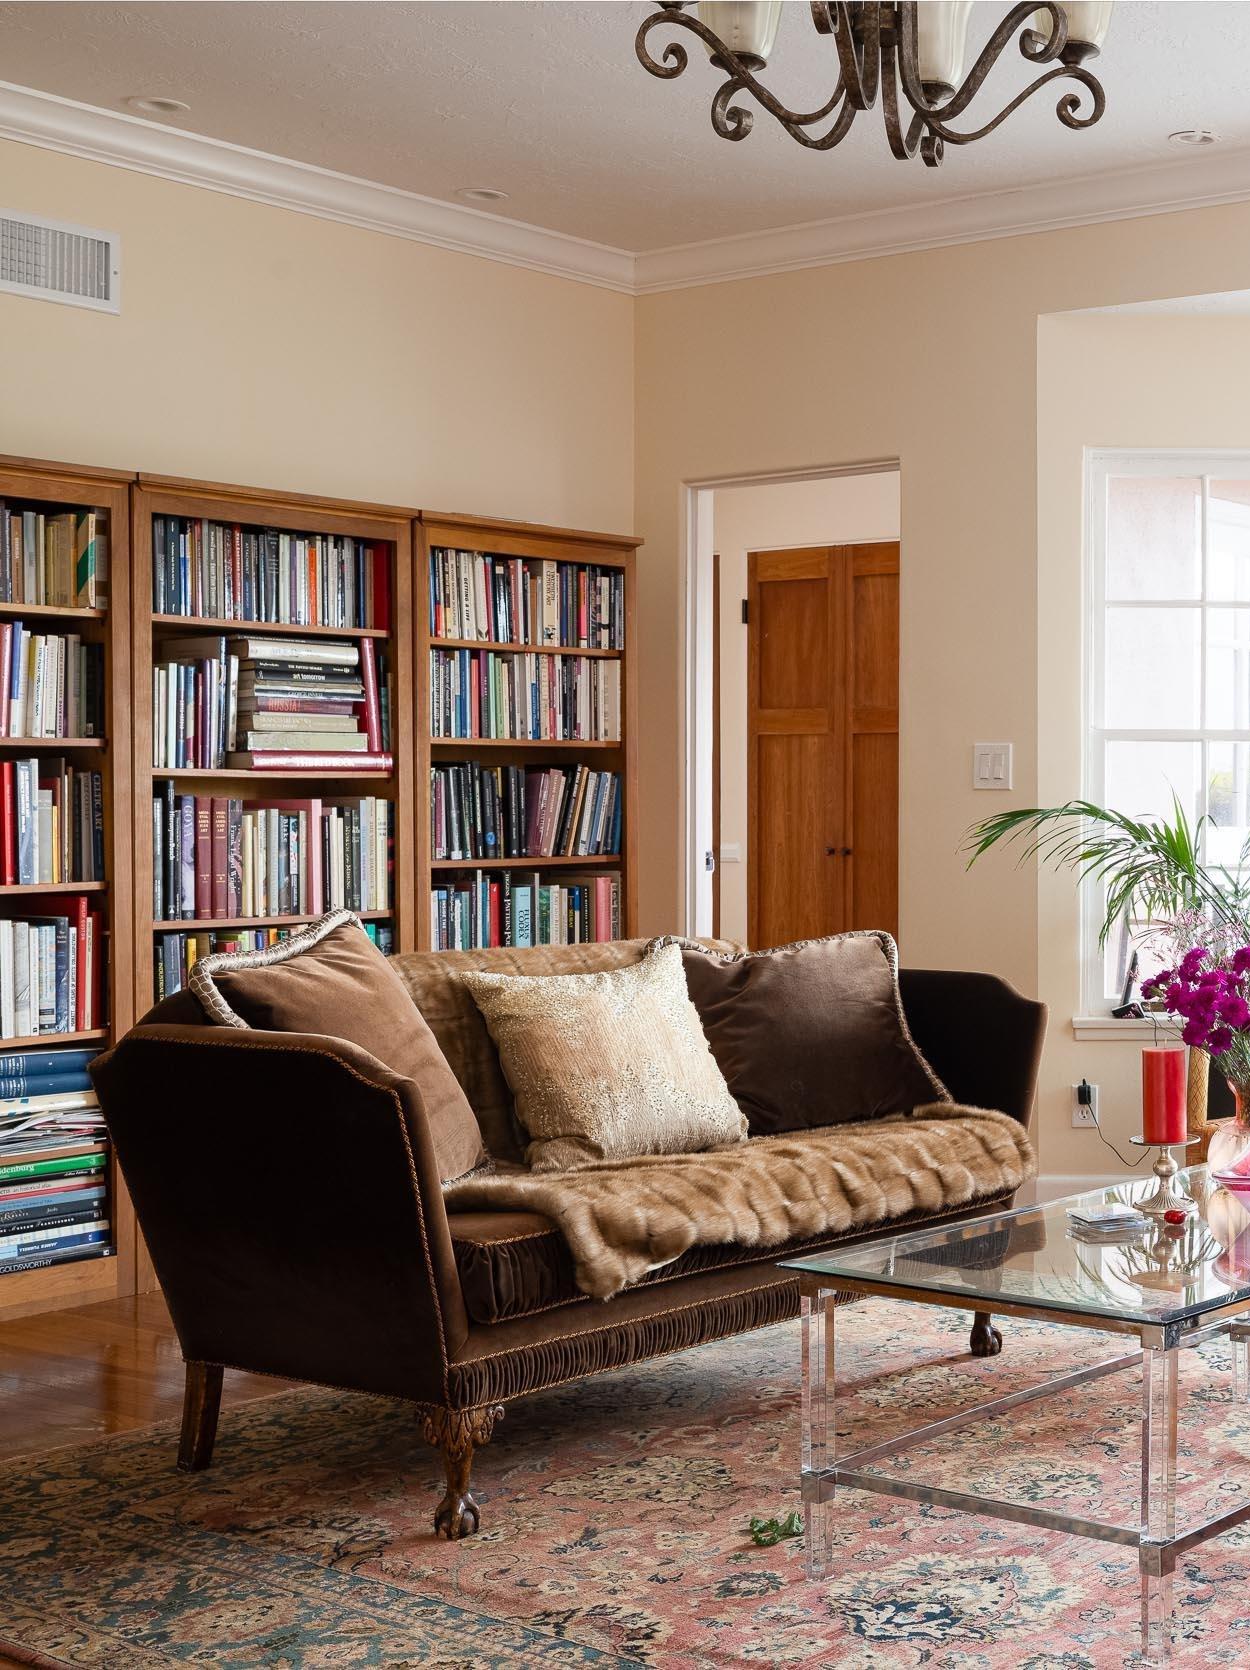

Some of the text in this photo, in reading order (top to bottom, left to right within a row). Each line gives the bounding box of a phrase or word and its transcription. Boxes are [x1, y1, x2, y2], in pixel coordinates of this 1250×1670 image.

[268, 699, 301, 712] RUSSIA!
[93, 774, 102, 809] CELTIC
[184, 805, 194, 838] GOYA
[0, 1259, 52, 1274] GOLDSWORTHY
